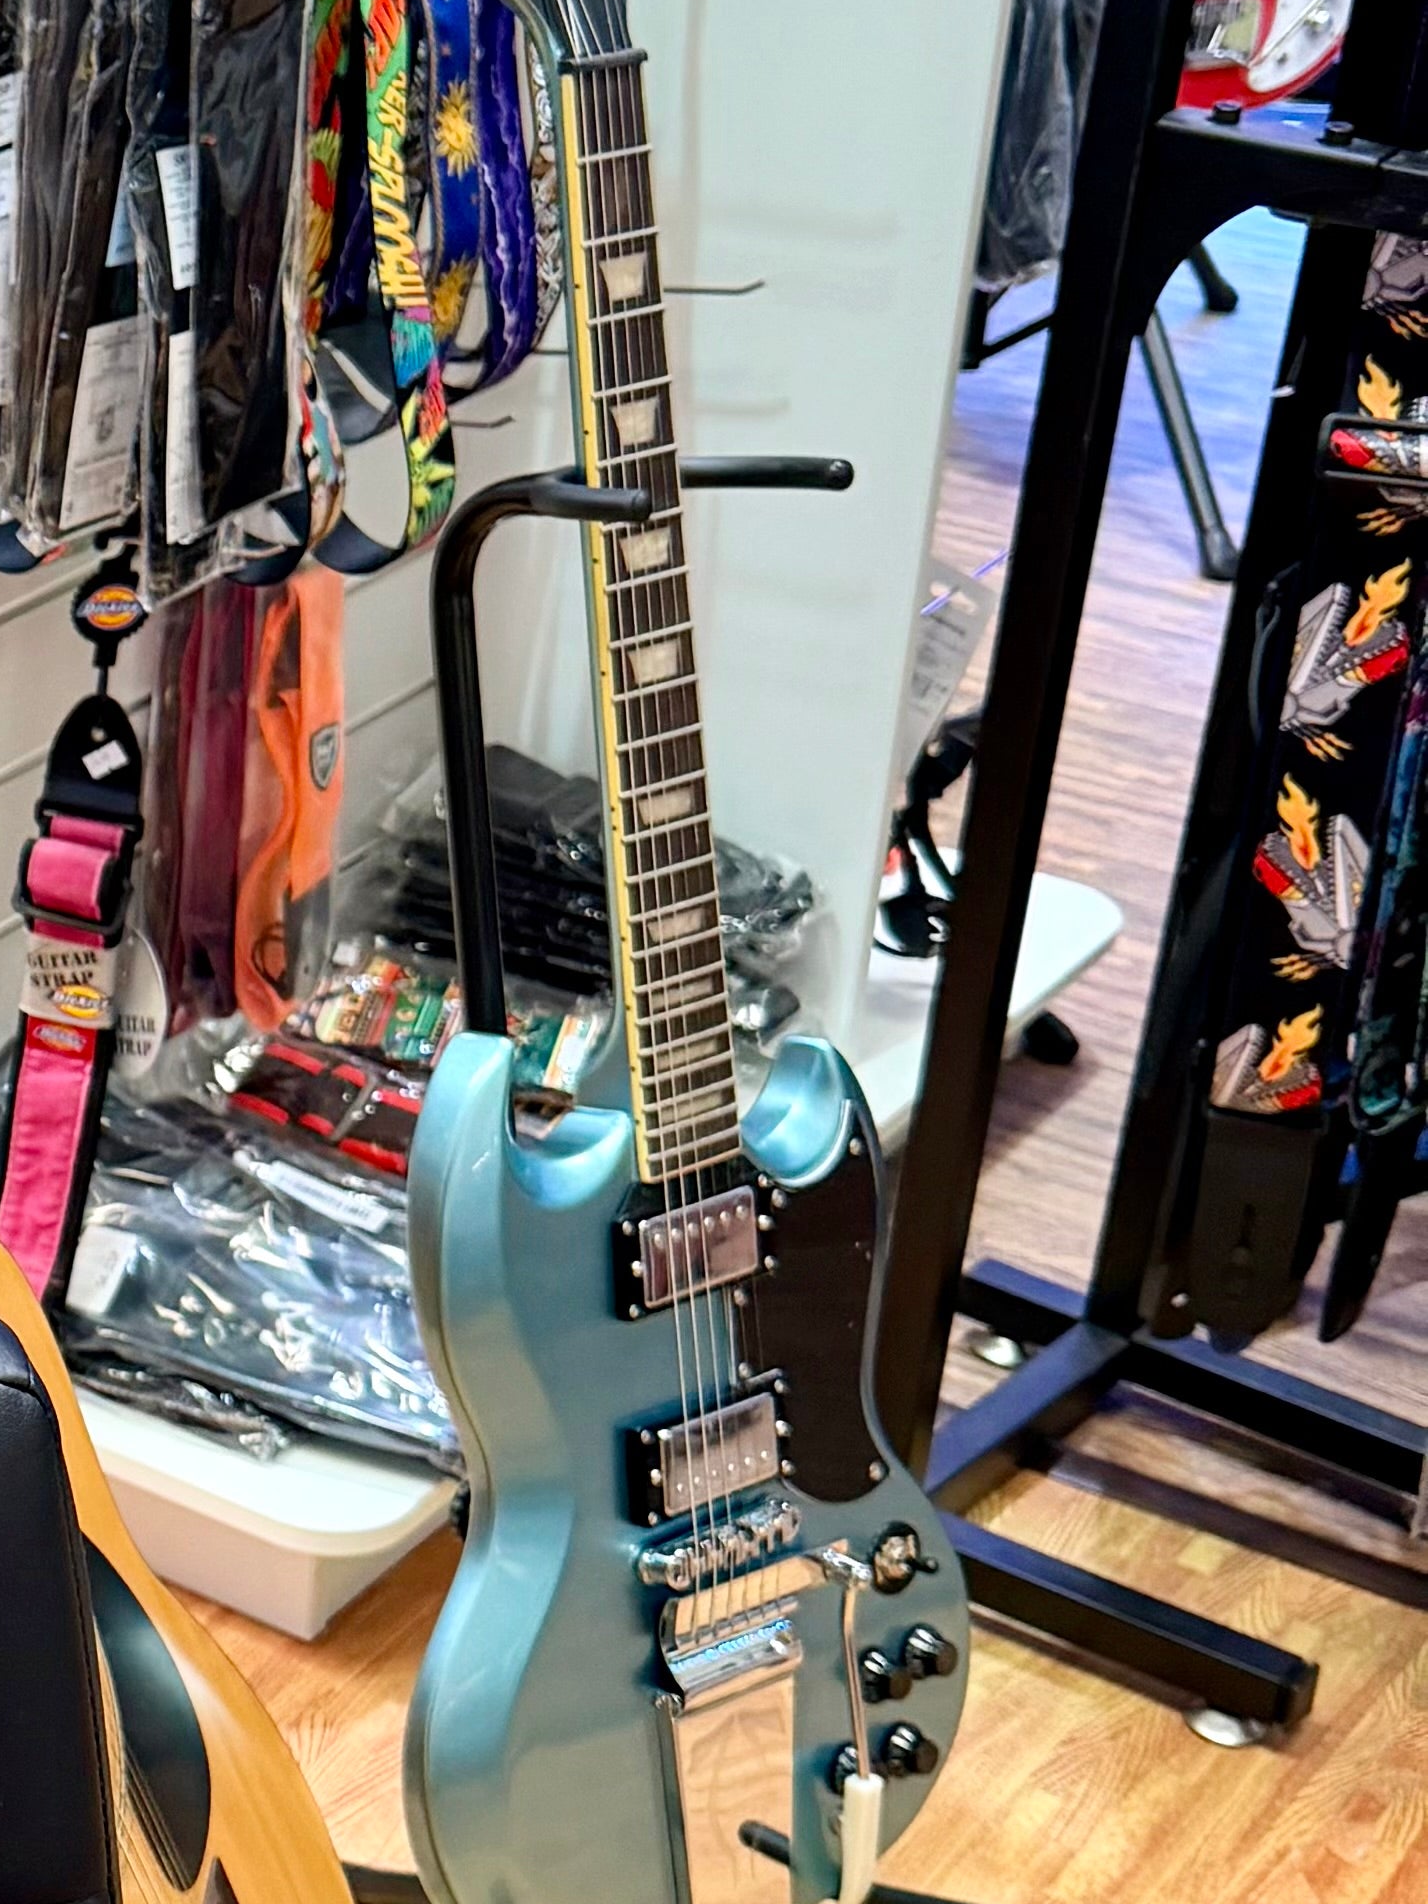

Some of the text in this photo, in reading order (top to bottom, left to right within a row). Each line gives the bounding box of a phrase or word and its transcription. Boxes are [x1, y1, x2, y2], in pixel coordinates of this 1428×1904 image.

[27, 950, 98, 970] GUITAR
[30, 970, 95, 988] STRAP
[117, 1014, 156, 1034] UITAR
[117, 1036, 153, 1057] TRAP
